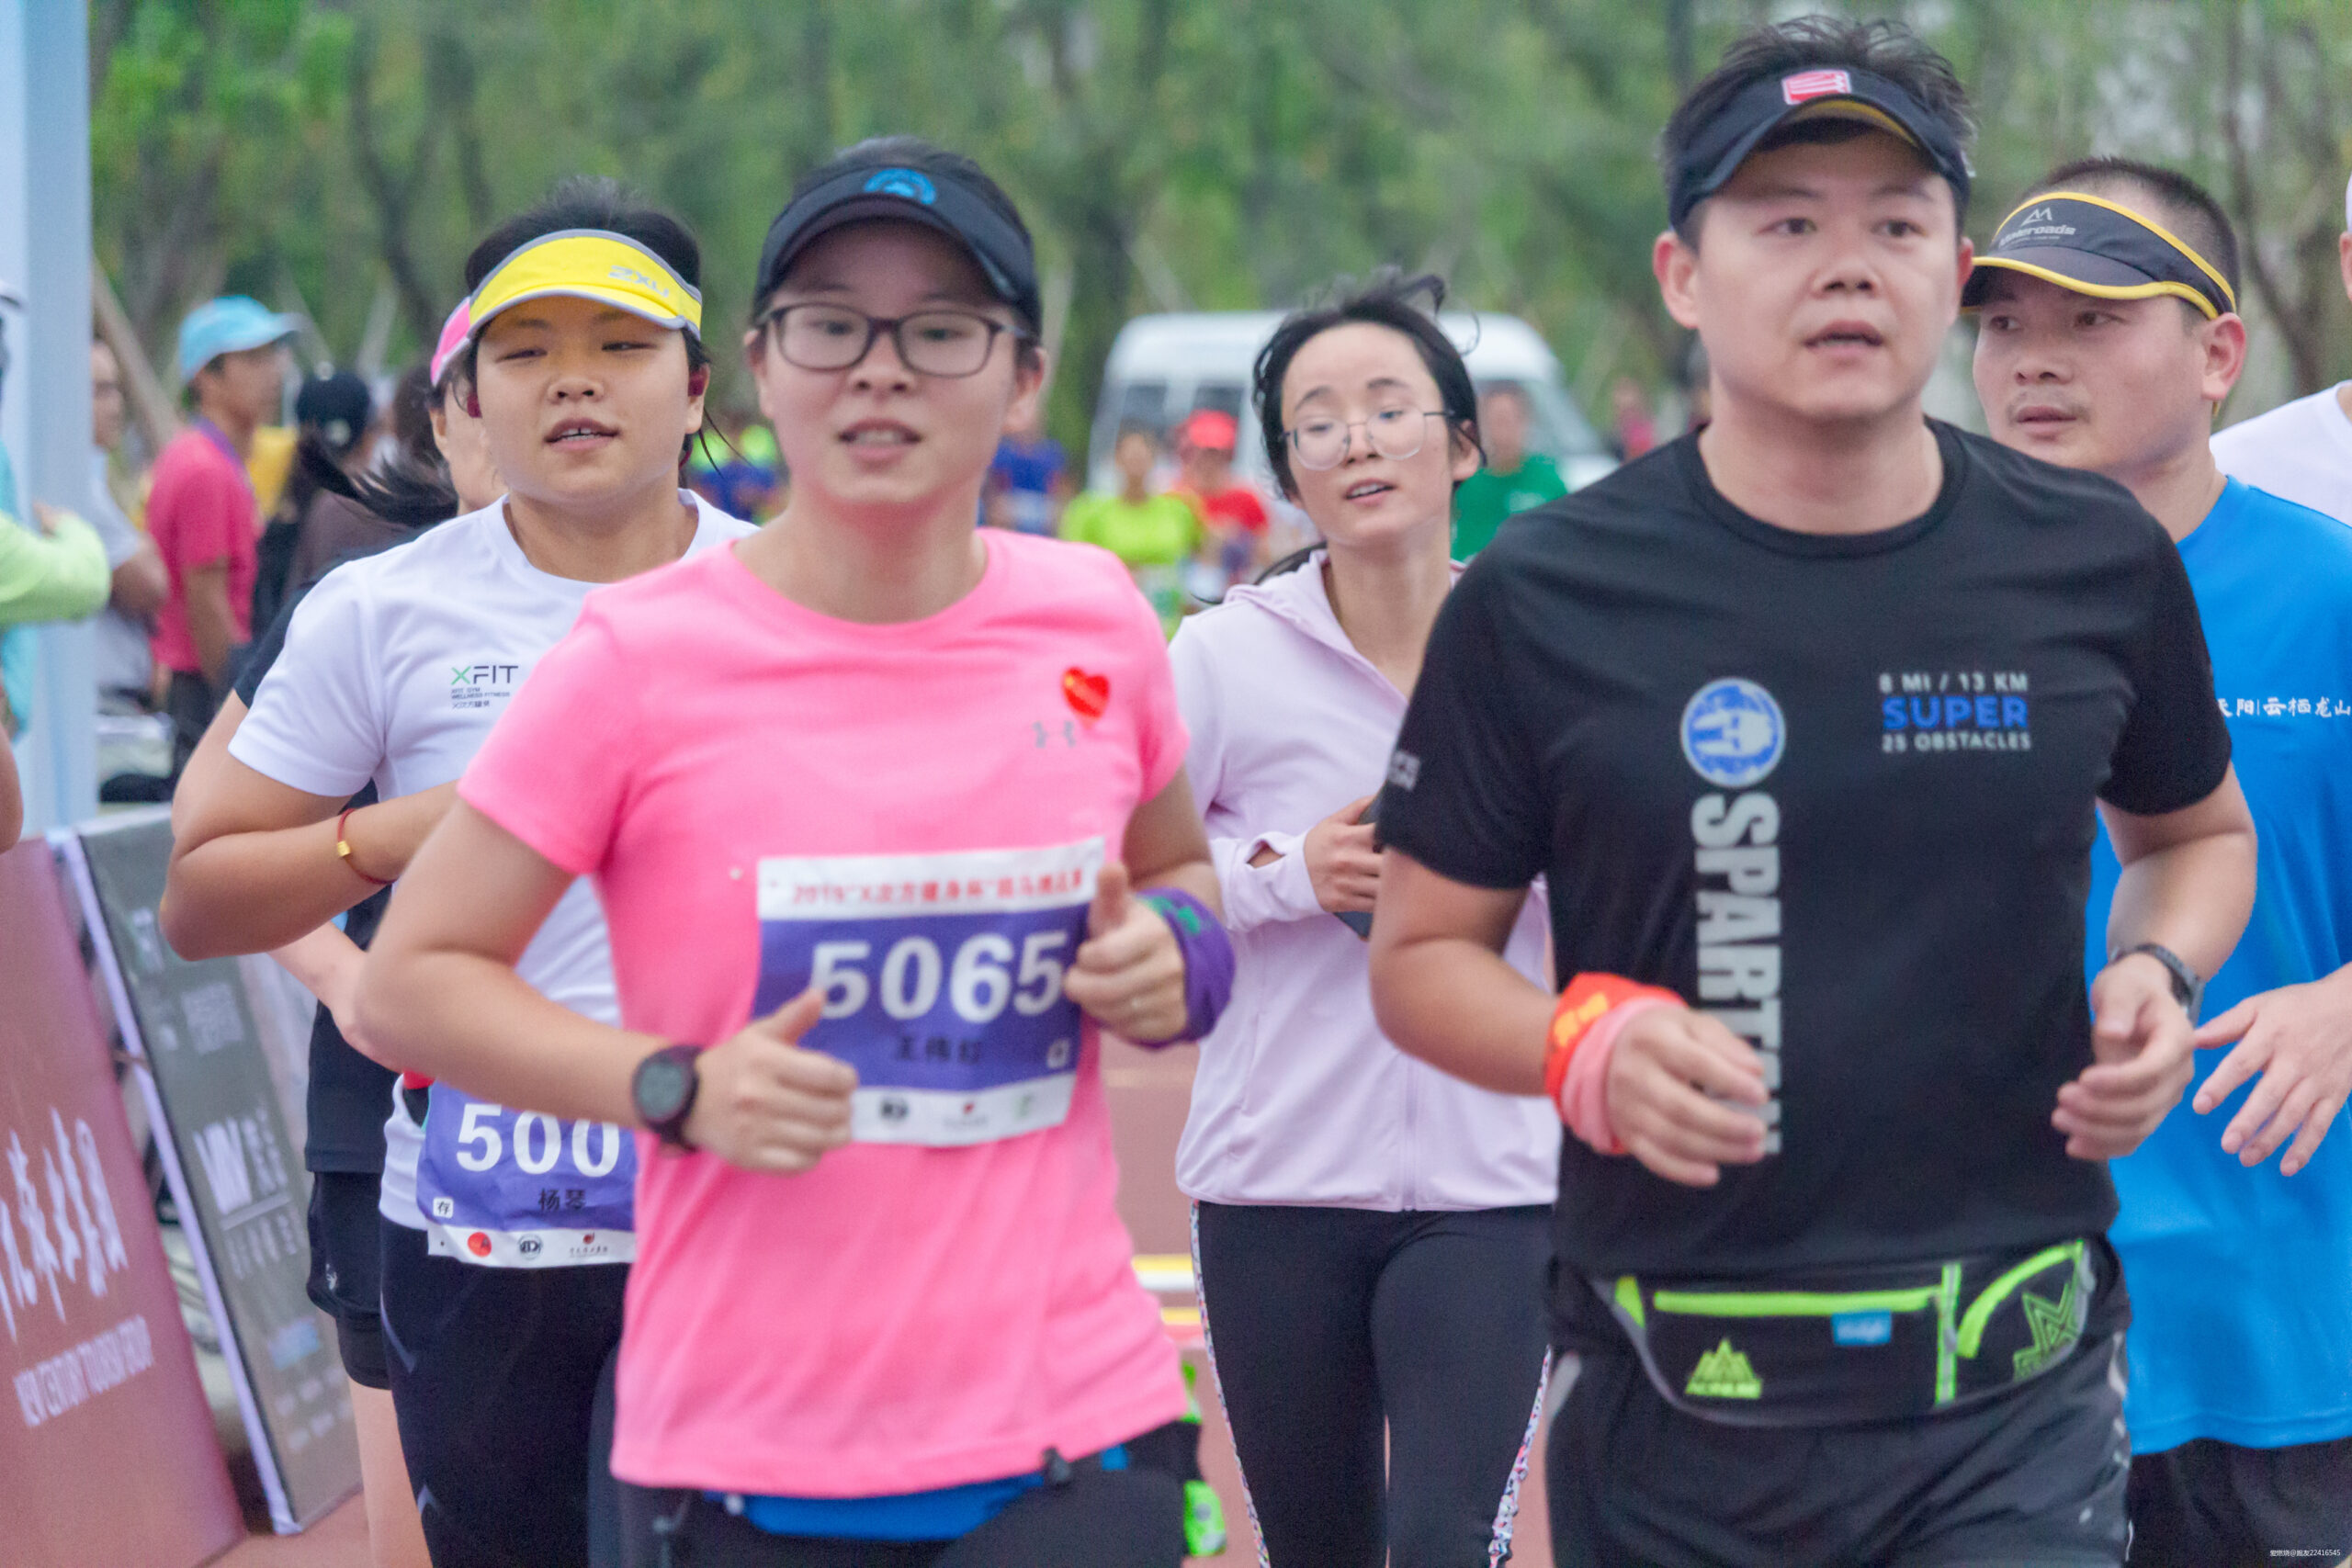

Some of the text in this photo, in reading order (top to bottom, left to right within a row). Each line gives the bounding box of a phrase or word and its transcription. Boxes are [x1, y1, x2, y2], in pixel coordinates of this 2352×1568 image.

[450, 665, 518, 685] XFIT
[1994, 671, 2027, 692] KM
[1883, 695, 2029, 729] SUPER
[1914, 731, 2030, 752] OBSTACLES
[810, 930, 1067, 1023] 5065
[1690, 792, 1782, 1155] SPART
[538, 1188, 586, 1211] 杨琴
